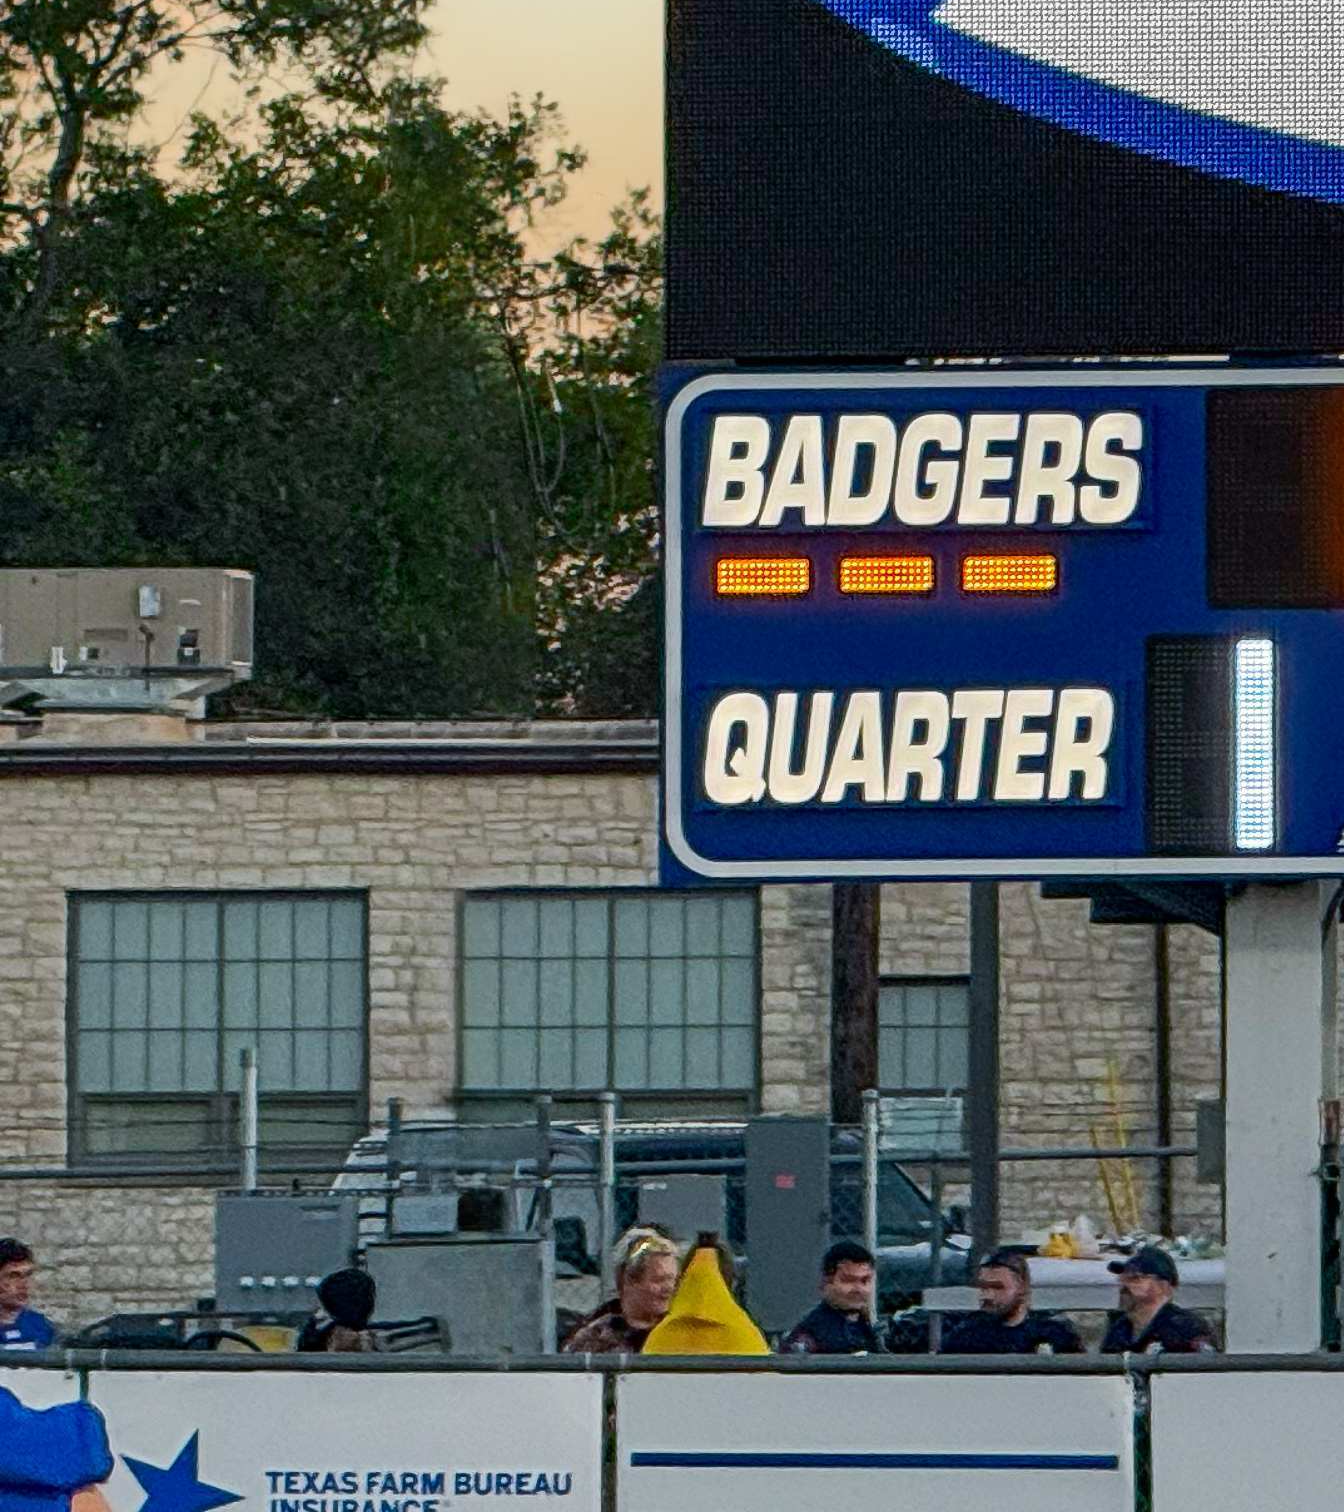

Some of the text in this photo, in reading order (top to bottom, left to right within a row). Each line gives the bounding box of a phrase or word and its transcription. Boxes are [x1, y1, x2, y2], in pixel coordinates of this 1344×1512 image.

[702, 411, 1142, 529] BADGERS
[706, 638, 1275, 850] QUARTER 1
[265, 1471, 573, 1496] TEXAS FARM BUREAU
